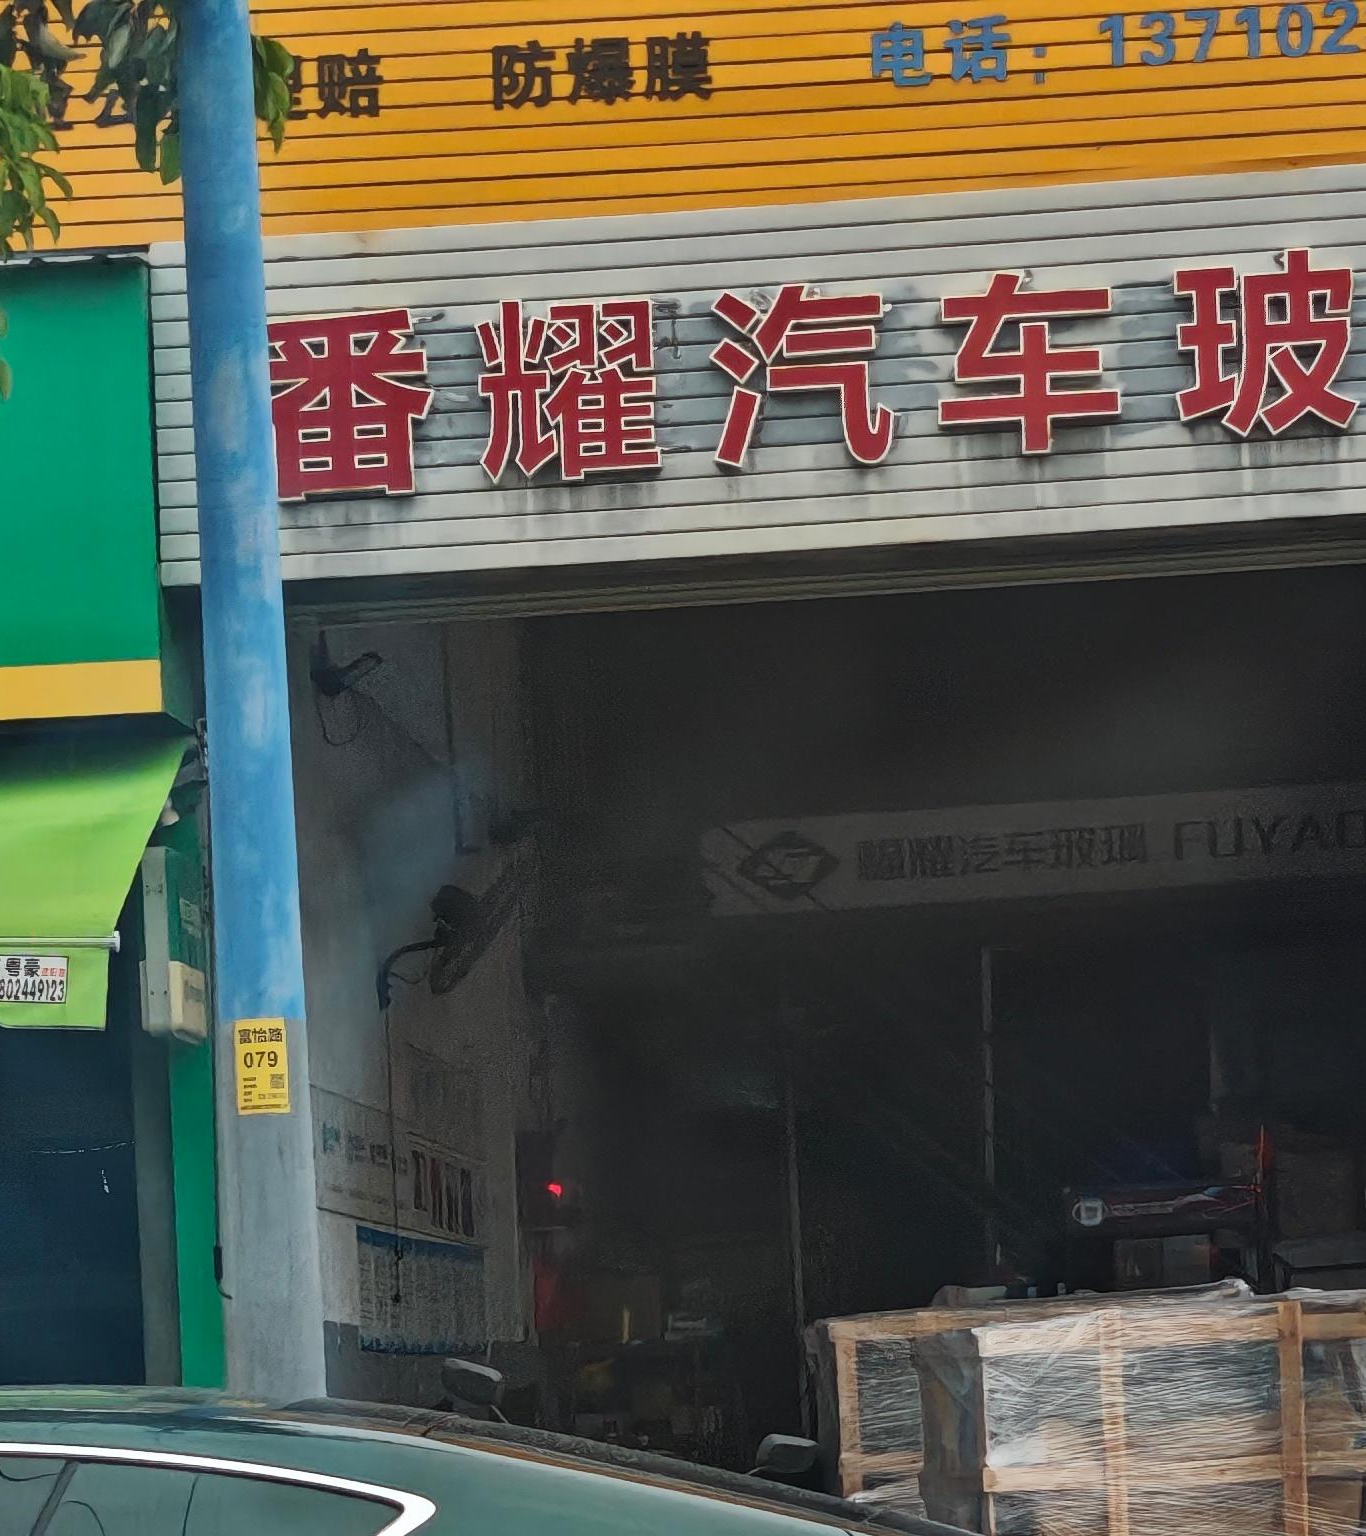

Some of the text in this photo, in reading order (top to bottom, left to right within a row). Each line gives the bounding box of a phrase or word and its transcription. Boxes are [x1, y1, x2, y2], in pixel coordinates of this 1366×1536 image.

[287, 31, 713, 119] 赔 防爆膜
[243, 1050, 278, 1068] 079
